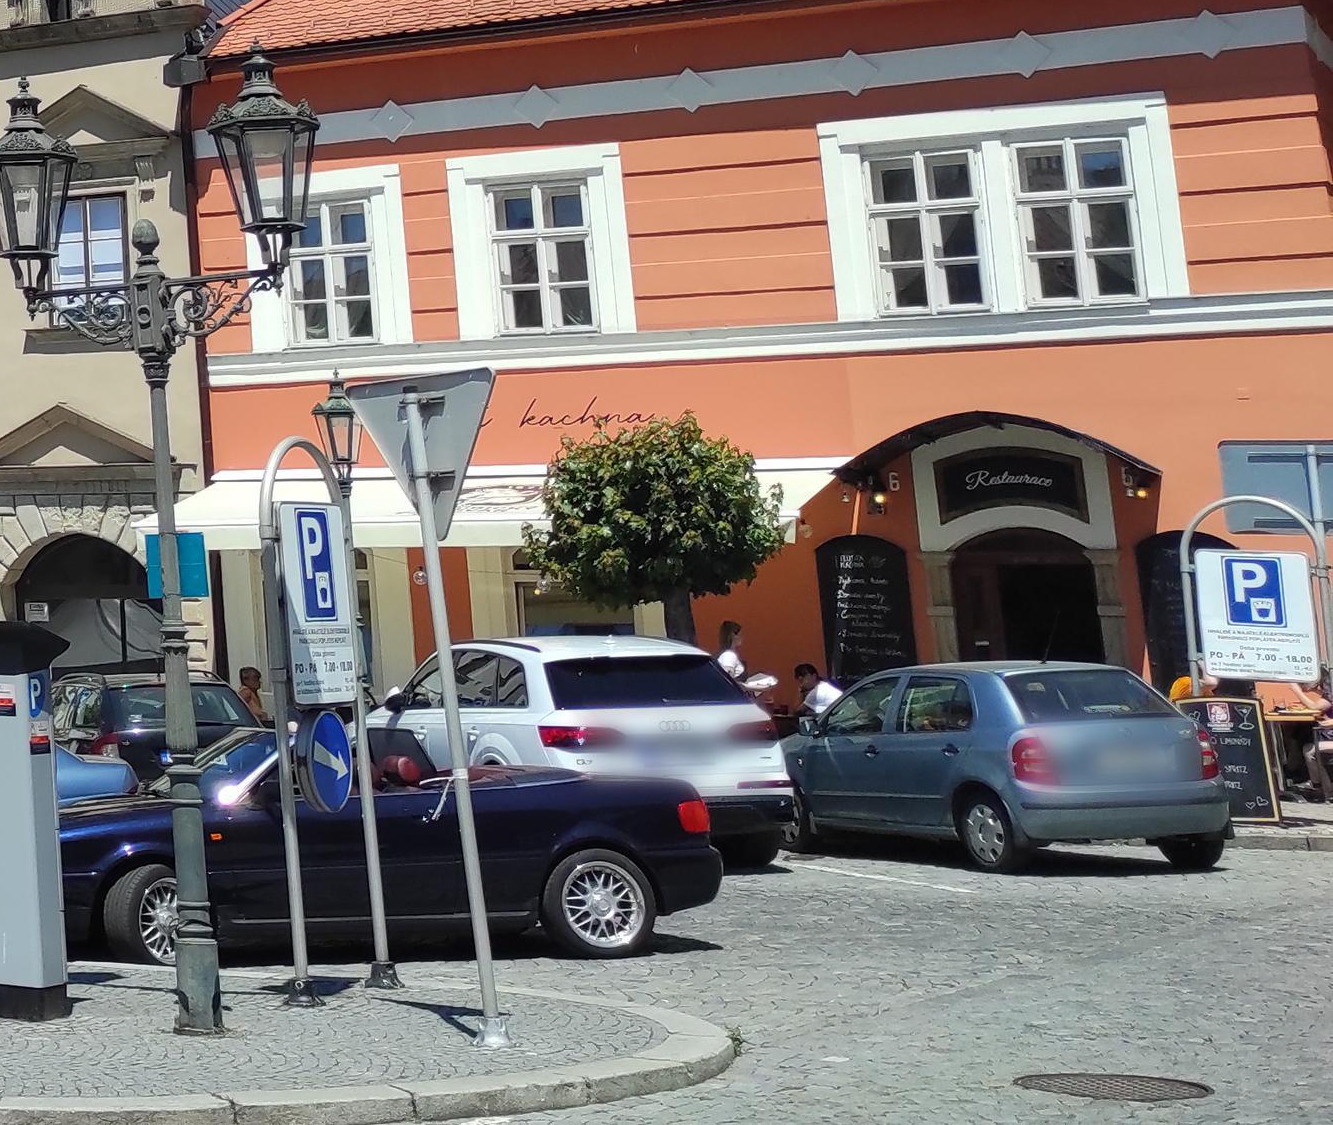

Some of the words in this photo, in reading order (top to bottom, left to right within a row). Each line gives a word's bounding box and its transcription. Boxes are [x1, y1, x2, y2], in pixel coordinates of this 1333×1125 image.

[519, 396, 655, 428] kachna
[889, 472, 900, 491] 6
[301, 517, 322, 579] P
[1232, 562, 1267, 602] P
[295, 663, 304, 674] PO
[1209, 651, 1223, 659] PO
[1232, 651, 1245, 660] PÁ
[1256, 653, 1277, 661] 7.00
[1286, 655, 1312, 663] 18.00
[30, 679, 41, 710] P
